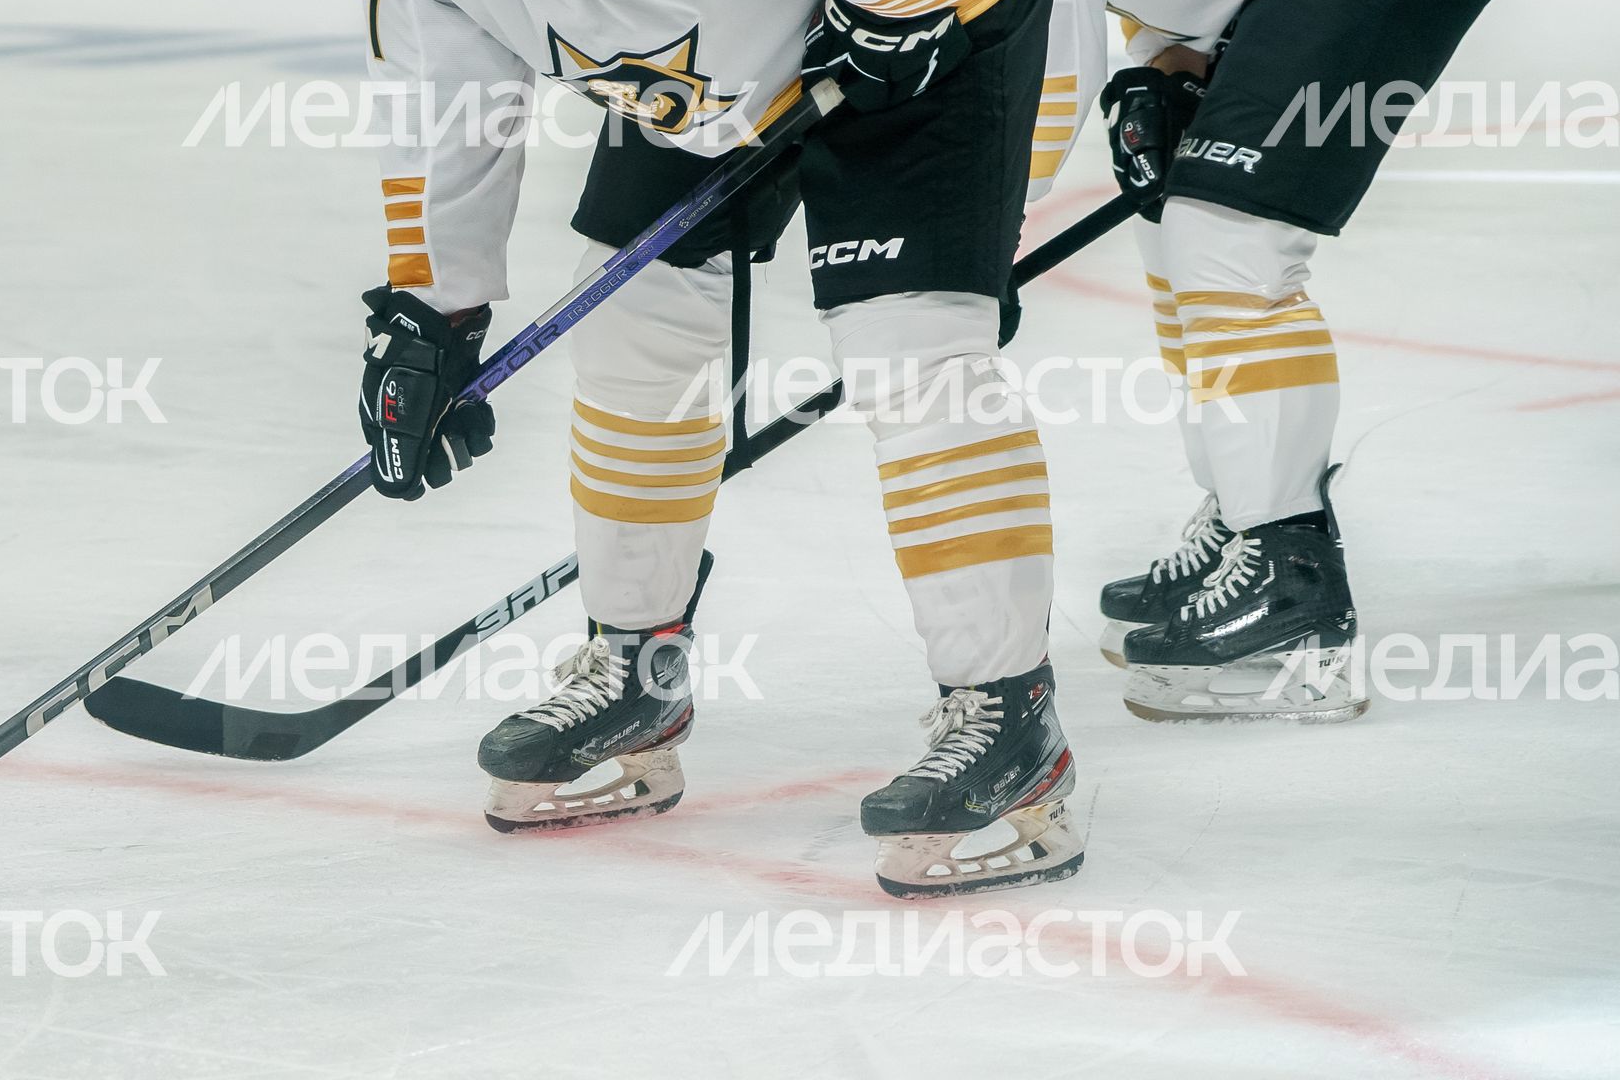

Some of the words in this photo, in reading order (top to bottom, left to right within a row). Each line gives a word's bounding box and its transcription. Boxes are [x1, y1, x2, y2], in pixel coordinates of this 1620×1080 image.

[1137, 153, 1156, 180] CCM
[809, 237, 905, 270] CCM
[384, 380, 398, 423] FT6
[393, 438, 405, 481] CCM
[25, 583, 215, 738] CCM
